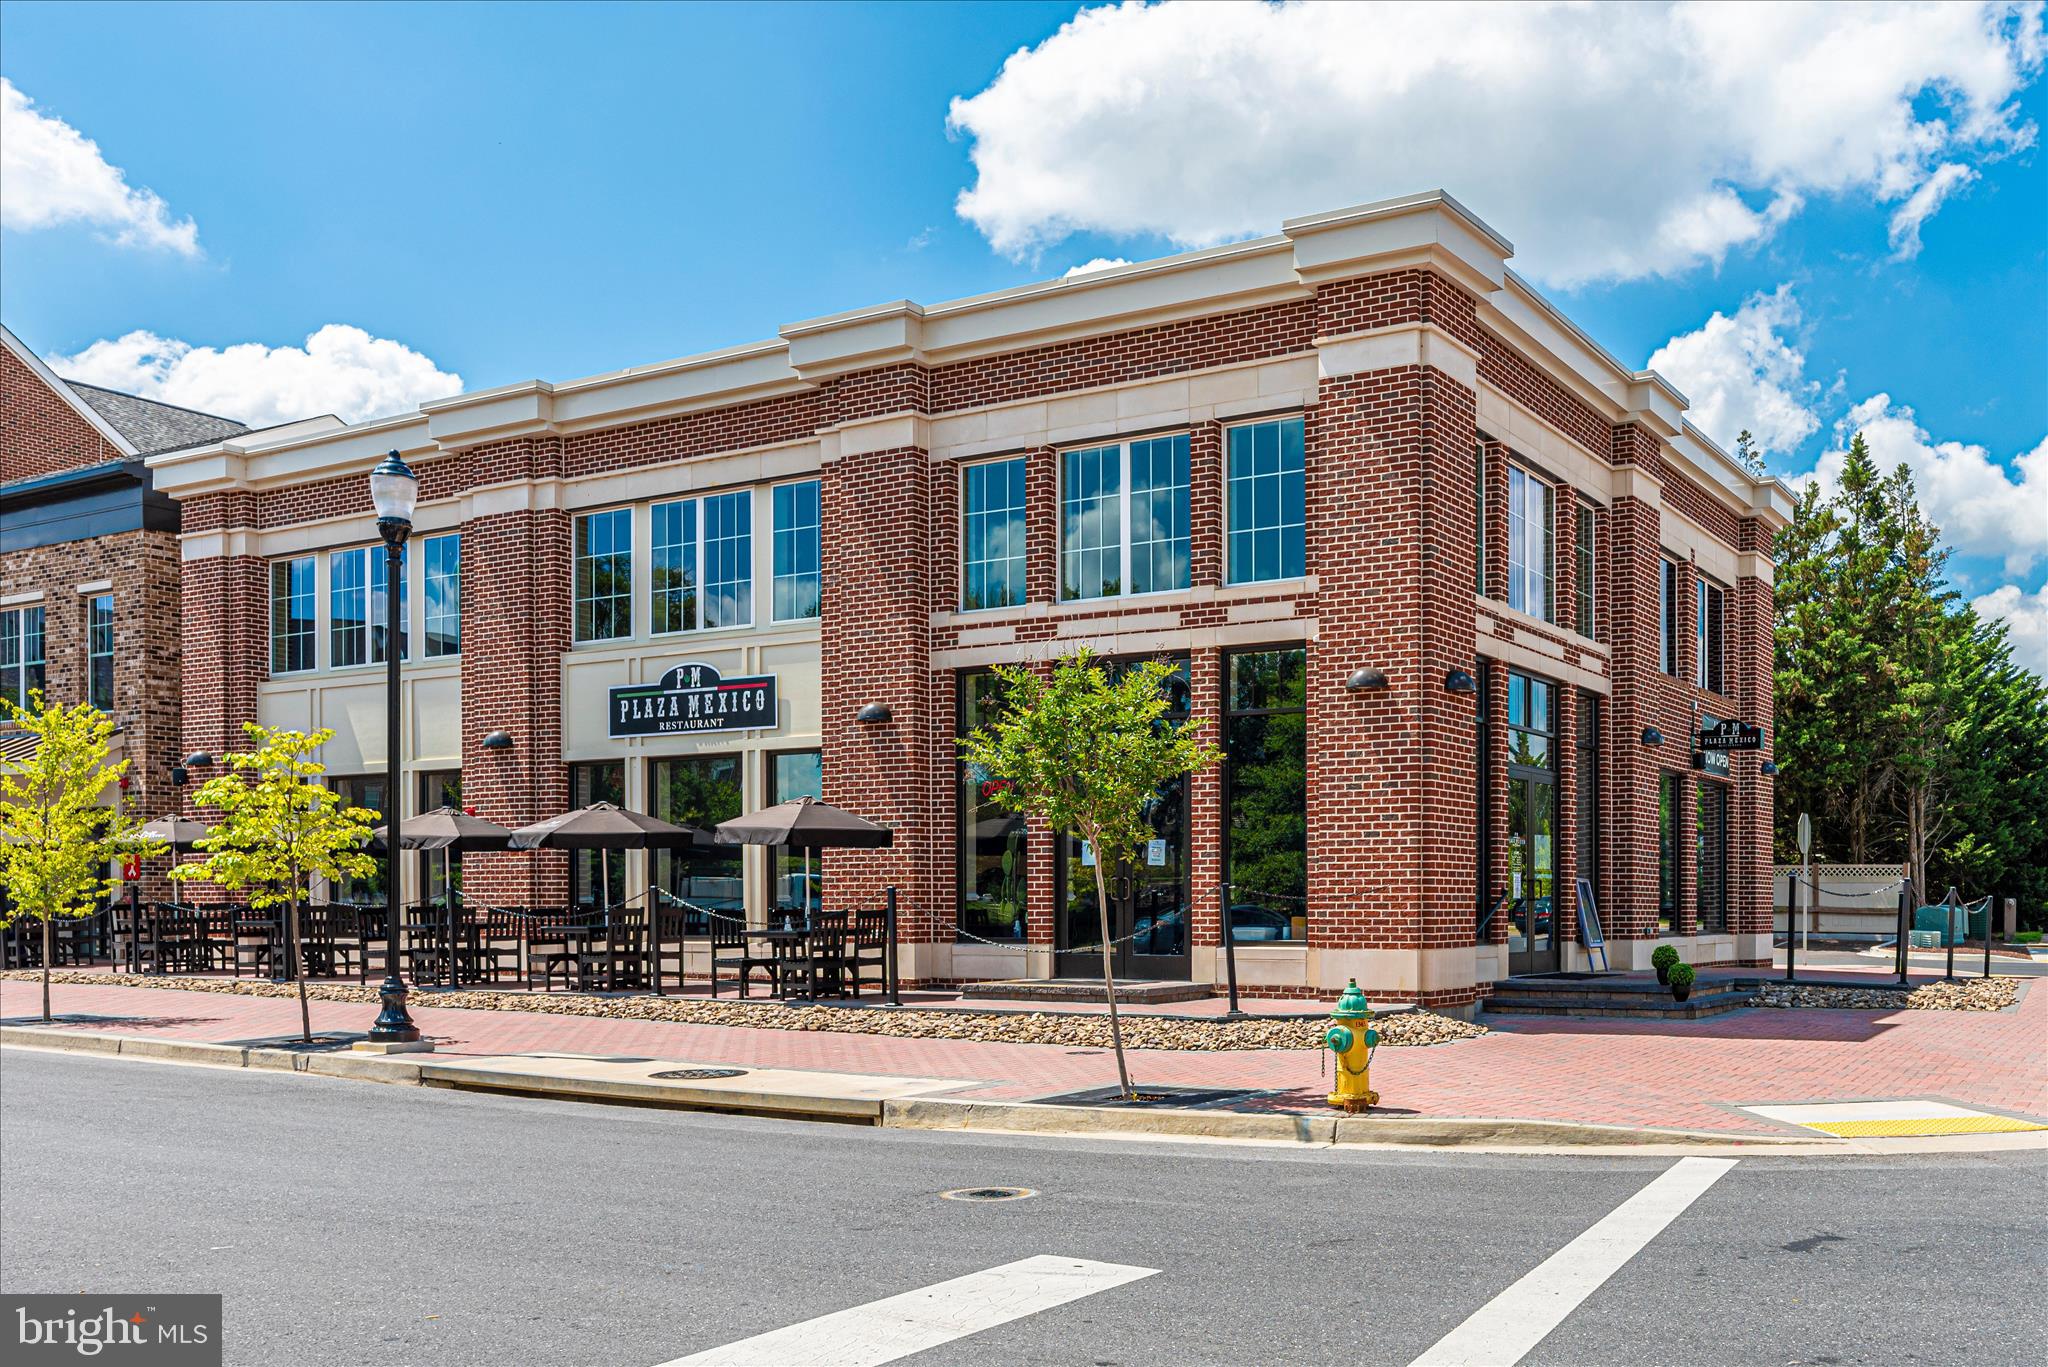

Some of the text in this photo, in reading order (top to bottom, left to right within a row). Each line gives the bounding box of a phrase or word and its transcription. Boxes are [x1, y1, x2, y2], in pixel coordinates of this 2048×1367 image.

[620, 689, 766, 723] PLAZA MEXICO
[659, 717, 724, 731] RESTAURANT
[1704, 736, 1757, 745] PLAZA MEXICO
